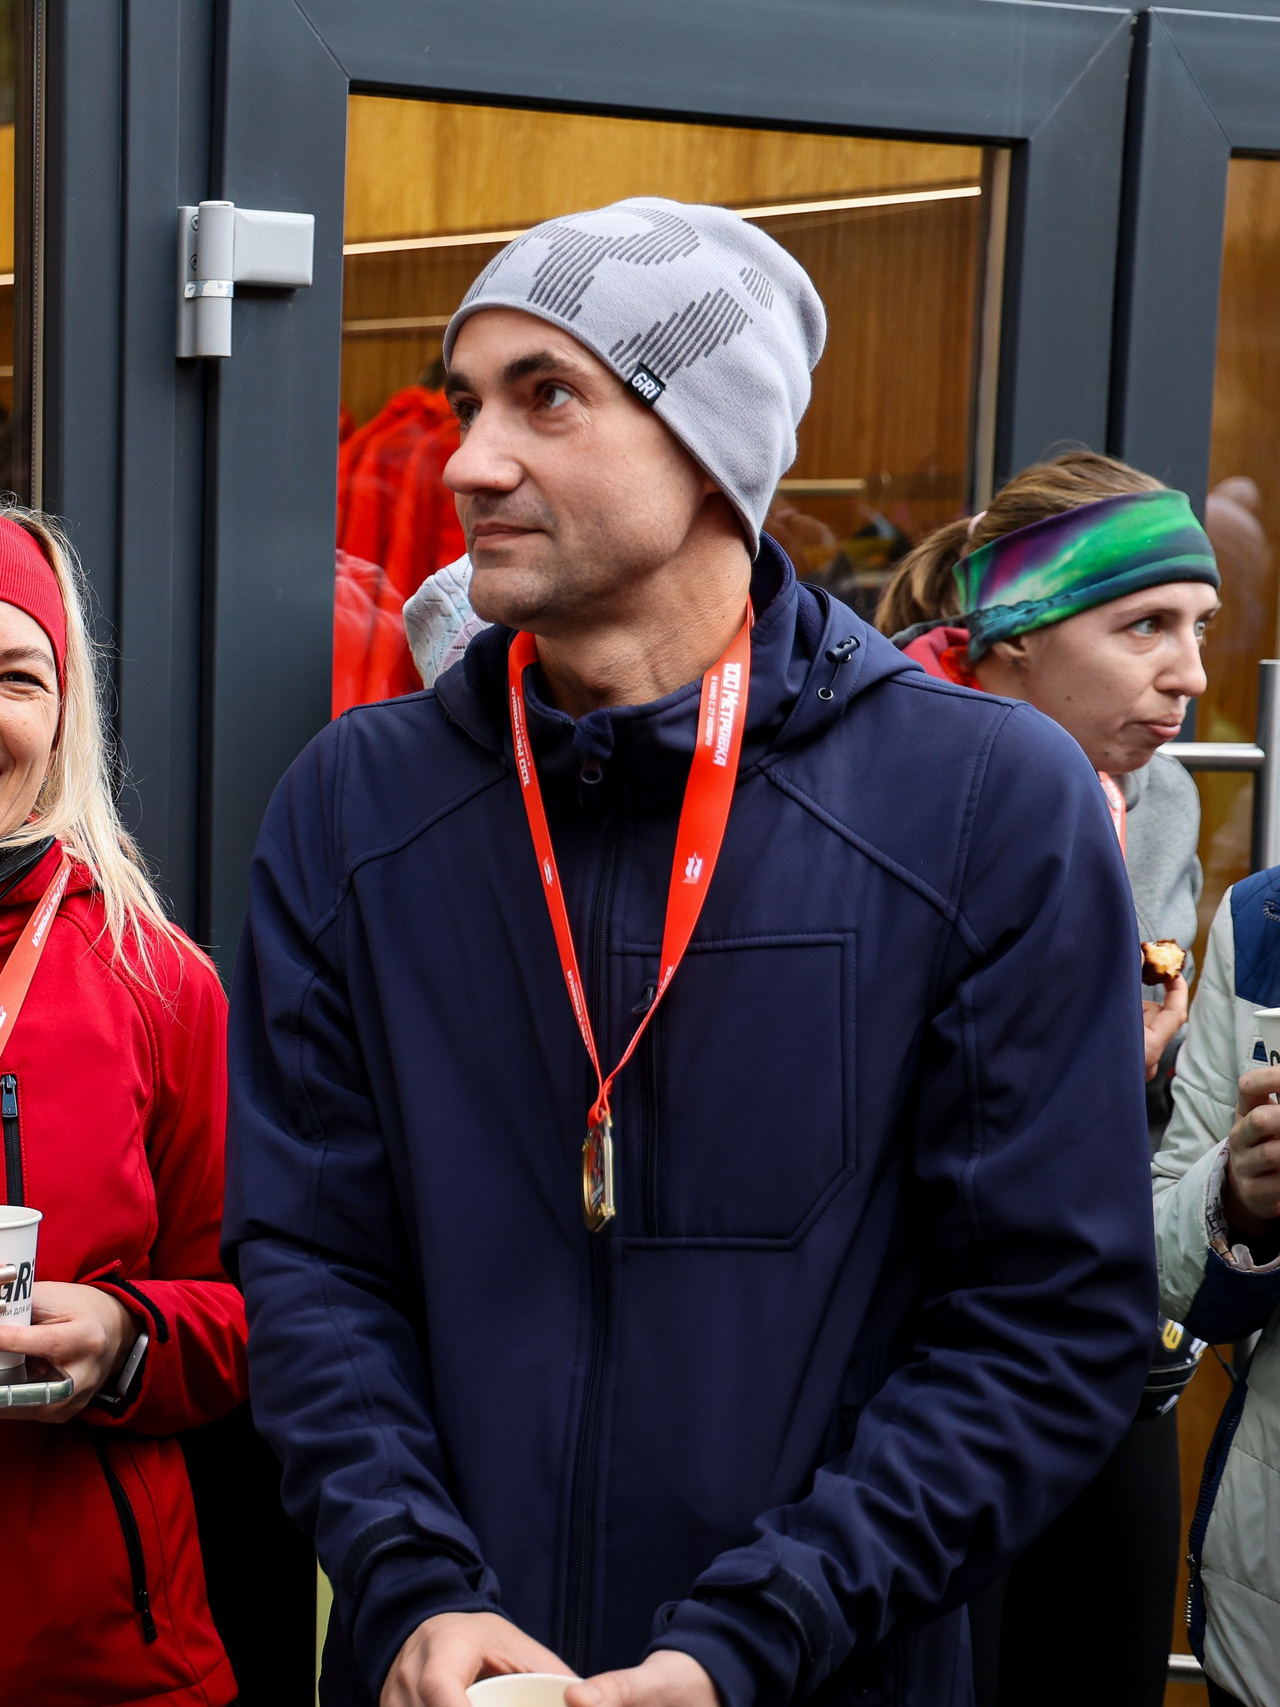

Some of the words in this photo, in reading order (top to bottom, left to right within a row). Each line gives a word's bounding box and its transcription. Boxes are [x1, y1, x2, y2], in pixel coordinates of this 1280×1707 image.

[631, 372, 661, 400] GRi
[723, 663, 740, 690] 100
[707, 706, 714, 715] 27
[518, 758, 529, 787] 100
